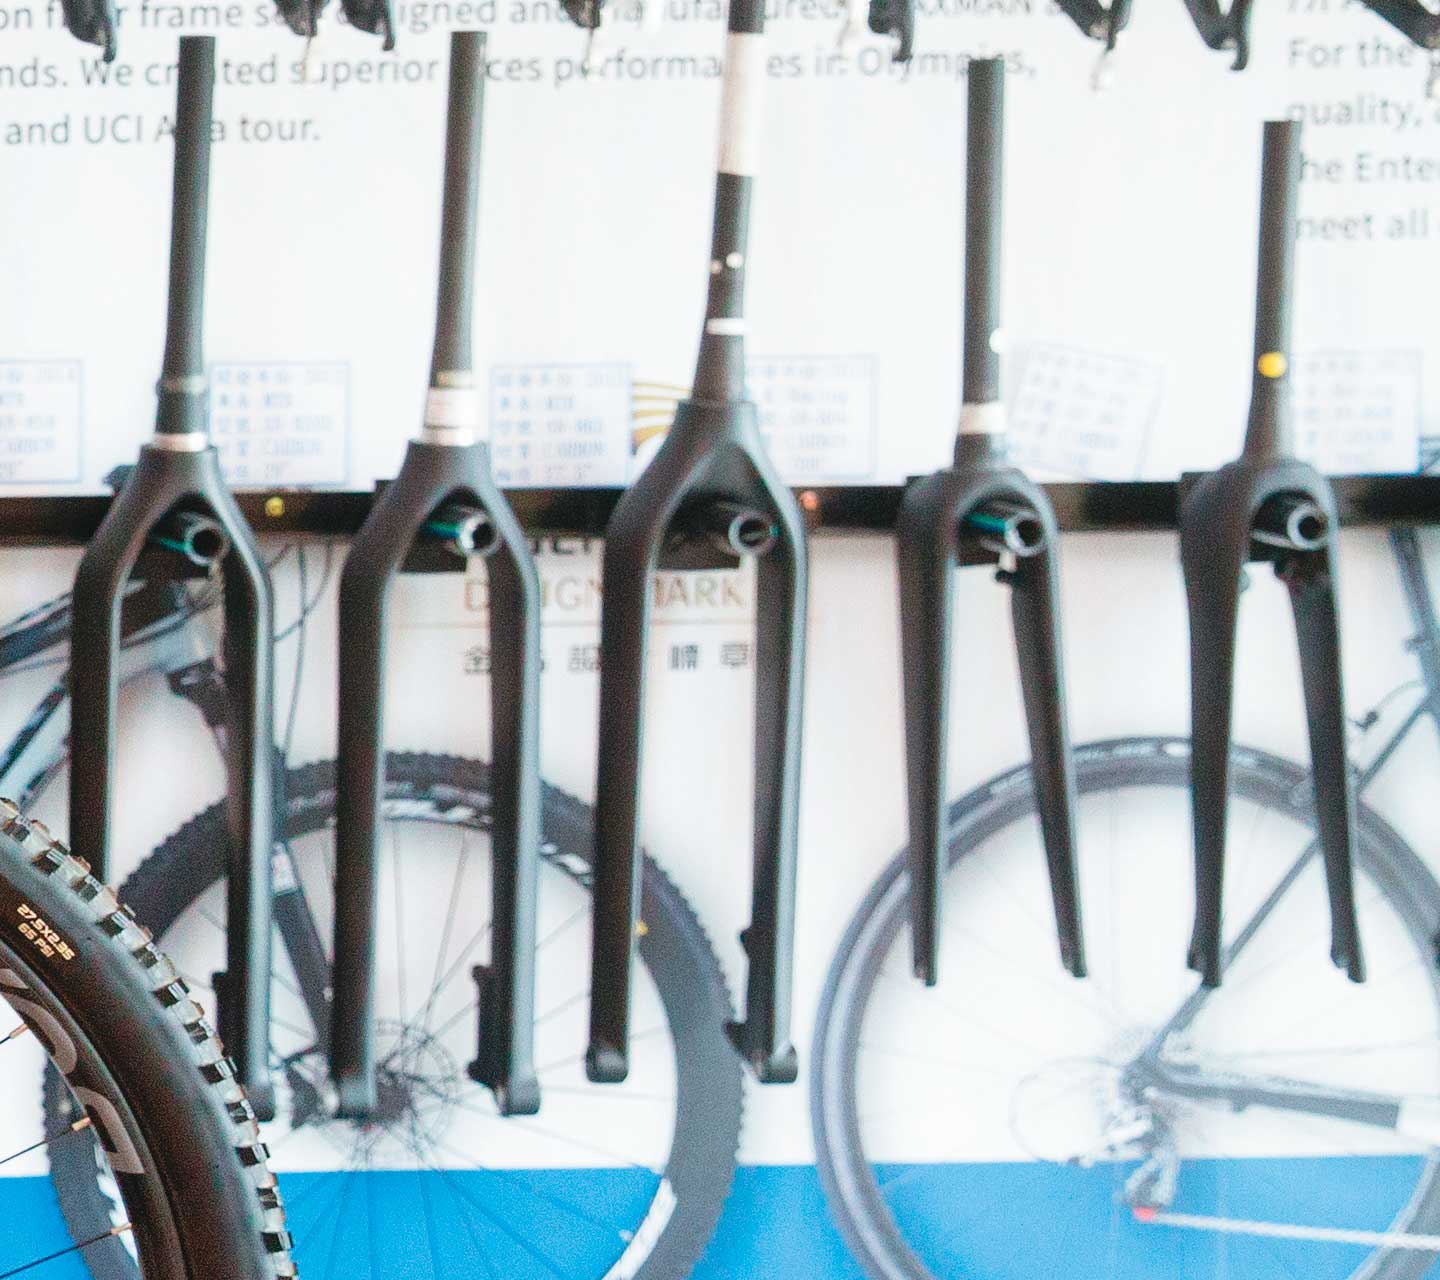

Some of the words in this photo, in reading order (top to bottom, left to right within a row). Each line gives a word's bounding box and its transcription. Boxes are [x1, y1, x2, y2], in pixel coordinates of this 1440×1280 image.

[144, 55, 278, 86] crted
[5, 114, 71, 145] and
[84, 115, 146, 144] UCI
[240, 117, 322, 144] tour.
[16, 902, 78, 962] 27.5X2.35
